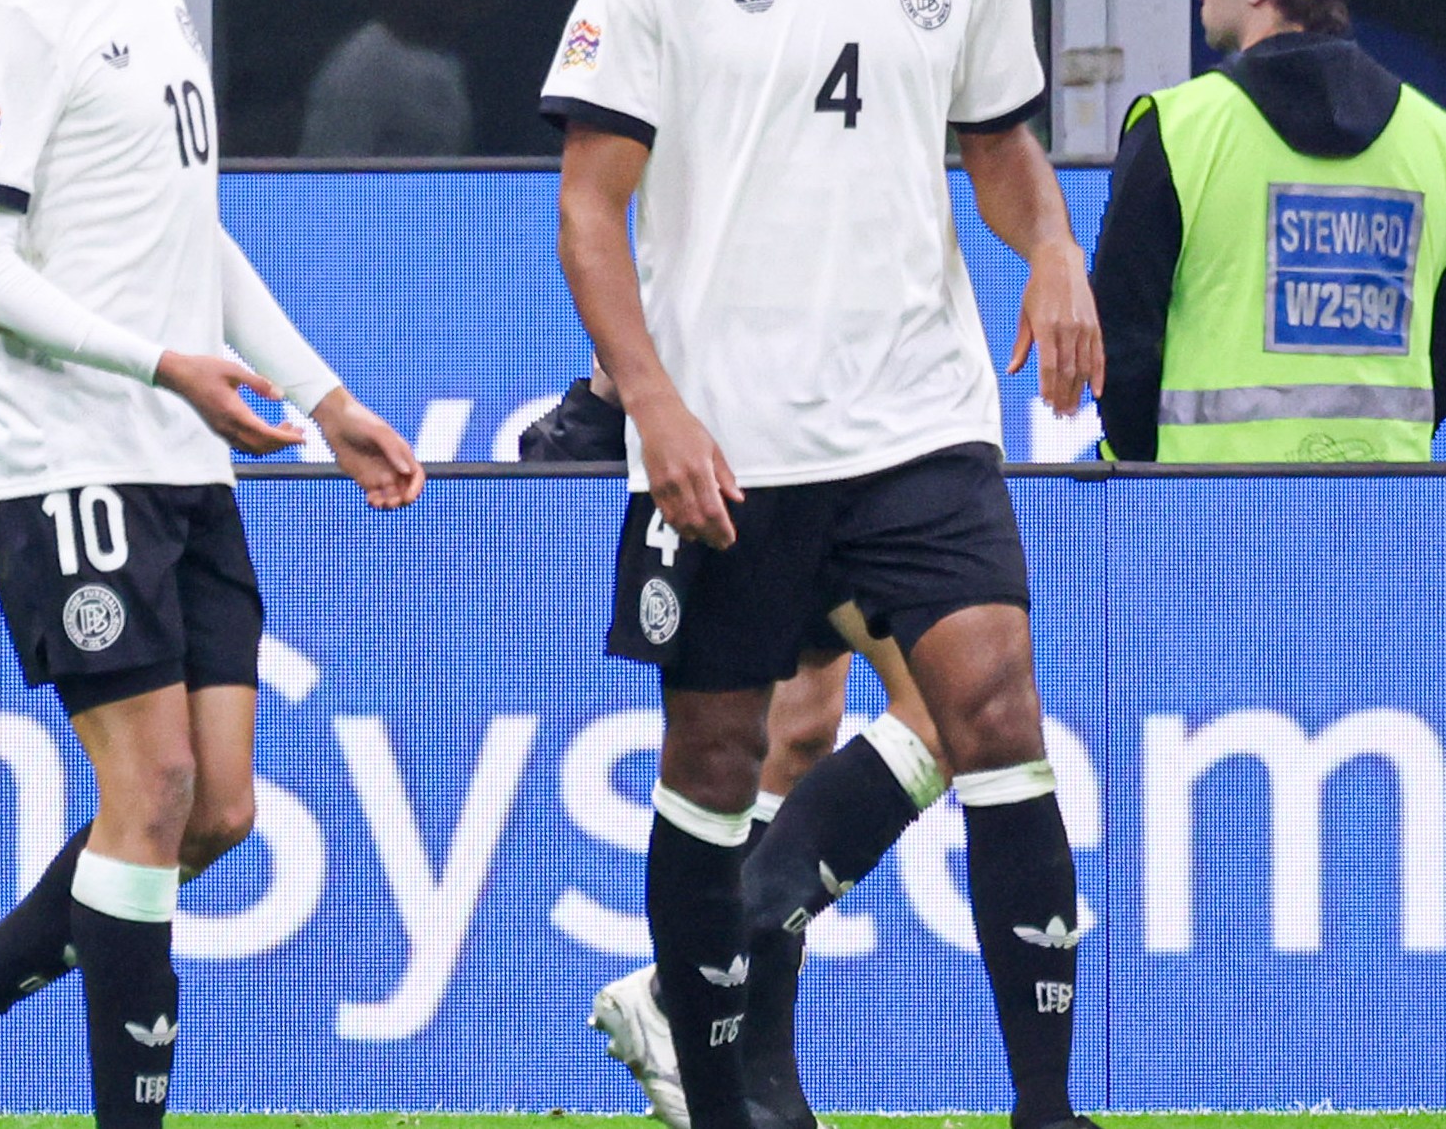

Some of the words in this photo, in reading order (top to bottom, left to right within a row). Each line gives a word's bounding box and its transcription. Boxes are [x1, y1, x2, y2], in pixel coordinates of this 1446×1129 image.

[164, 80, 209, 169] 10
[814, 42, 862, 129] 4
[1281, 209, 1405, 258] STEWARD
[1284, 280, 1399, 330] W2599
[42, 485, 129, 576] 10
